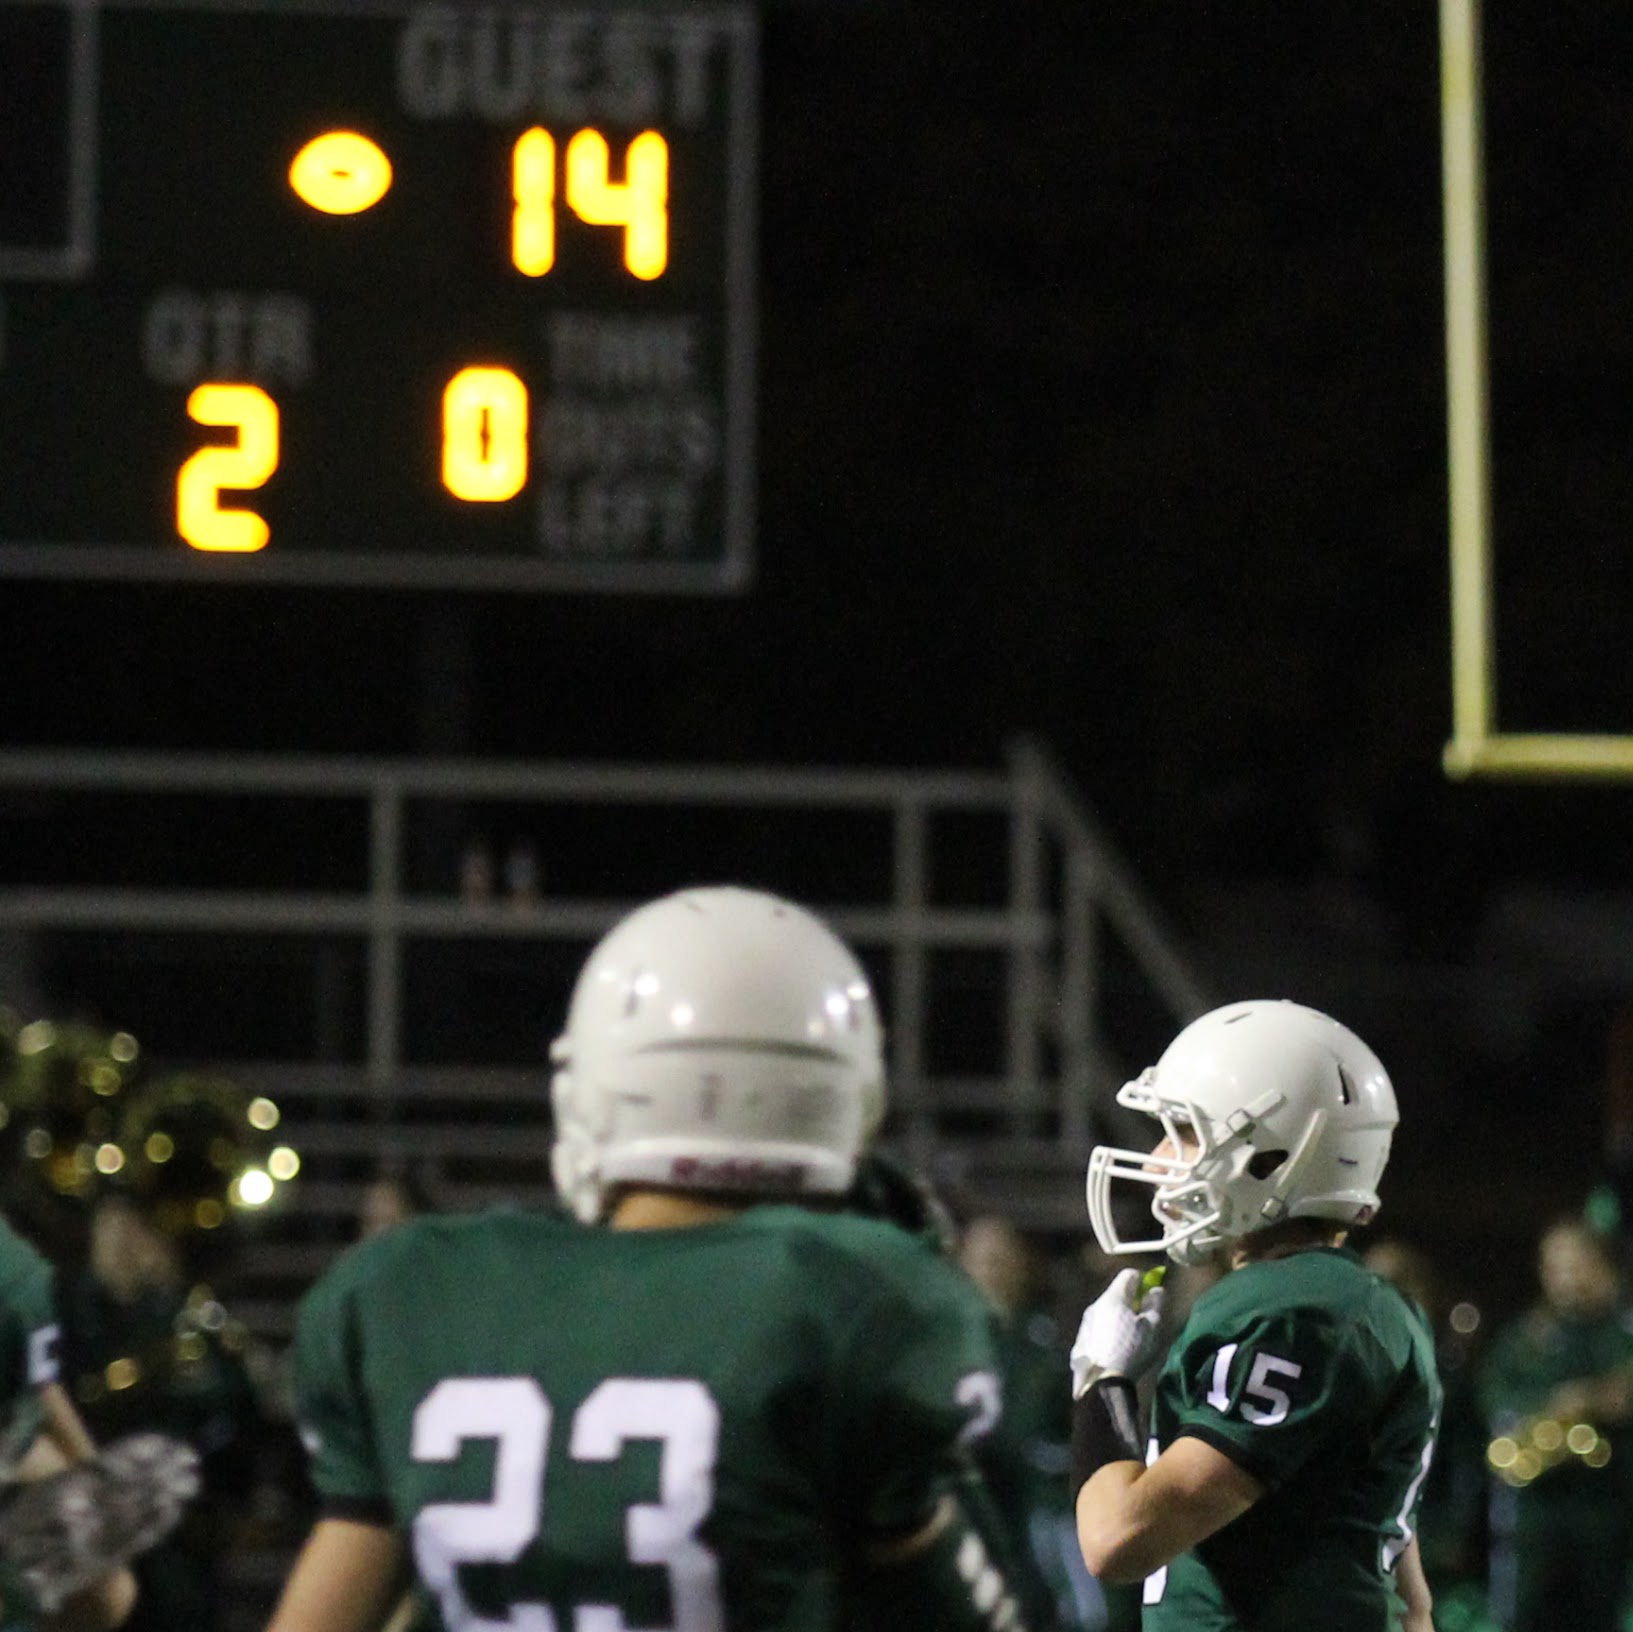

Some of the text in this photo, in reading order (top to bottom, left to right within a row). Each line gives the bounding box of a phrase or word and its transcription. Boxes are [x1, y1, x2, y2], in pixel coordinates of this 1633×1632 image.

[400, 3, 722, 122] GUEST
[512, 126, 669, 280] 14
[176, 382, 280, 553] 2
[442, 364, 528, 502] 0
[1206, 1342, 1302, 1426] 15
